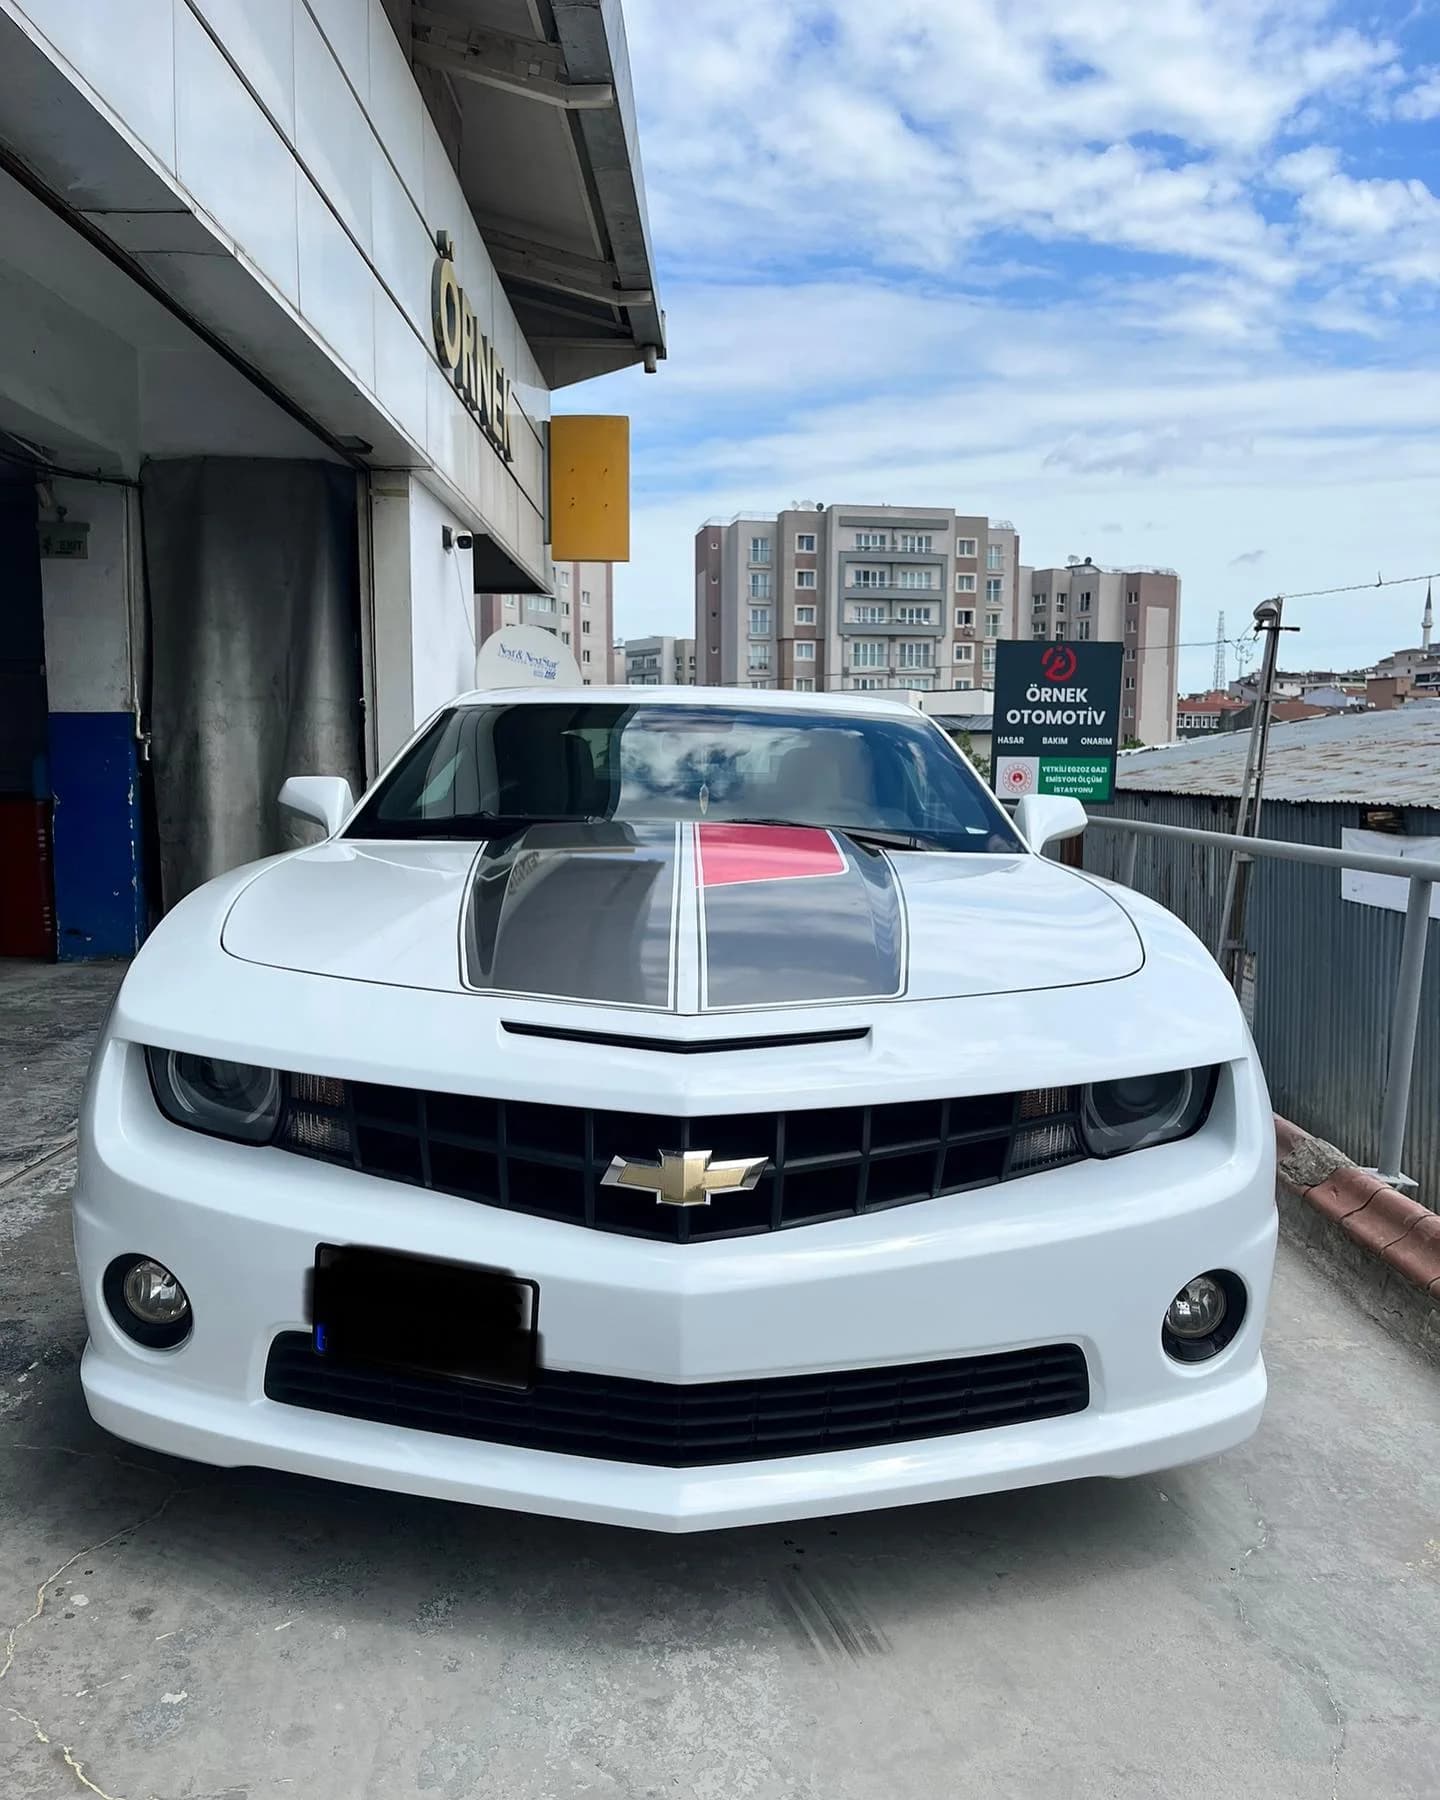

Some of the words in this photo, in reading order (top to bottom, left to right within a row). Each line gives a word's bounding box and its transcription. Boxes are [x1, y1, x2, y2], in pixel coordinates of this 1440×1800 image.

[1026, 683, 1088, 703] ÖRNEK
[1006, 707, 1106, 725] OTOMOTİV
[997, 736, 1025, 745] HASAR
[1042, 736, 1068, 745] BAKIM
[1080, 737, 1113, 746] ONARIM
[1042, 764, 1067, 773] YETKİLİ
[1090, 766, 1107, 774] GAZI
[1045, 775, 1077, 783] EMİSYON
[1077, 775, 1103, 785] ÖLÇÜM
[1053, 785, 1094, 793] İSTASYONU
